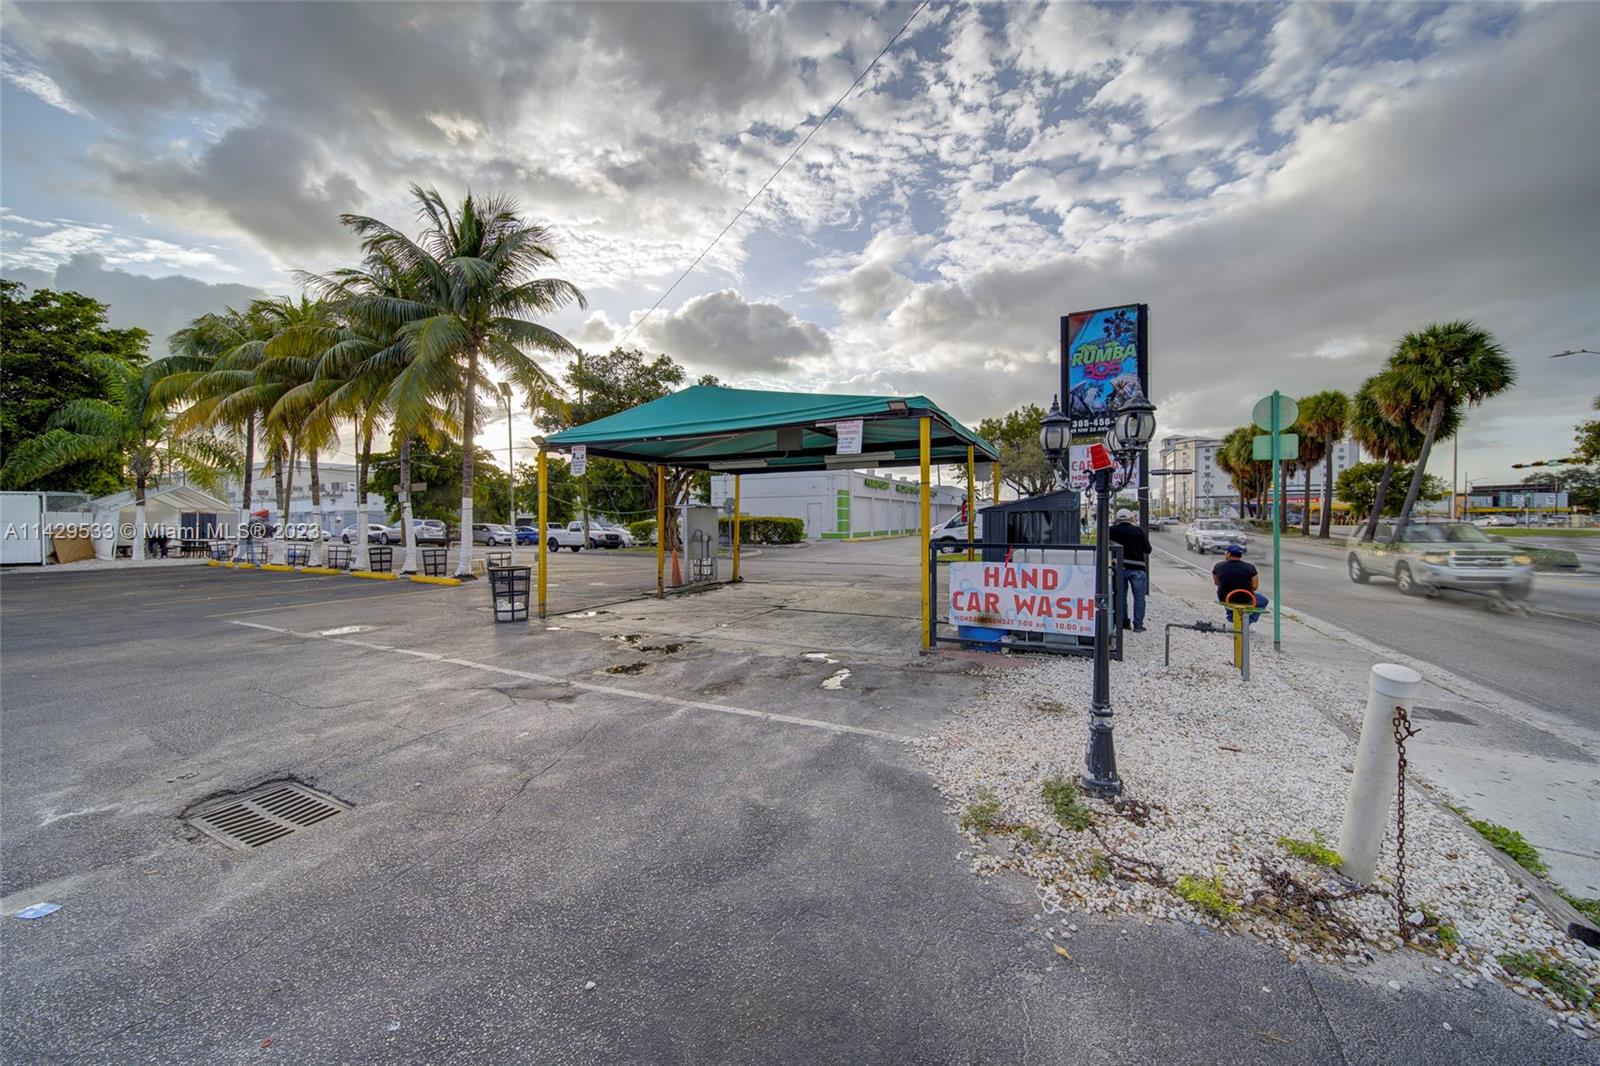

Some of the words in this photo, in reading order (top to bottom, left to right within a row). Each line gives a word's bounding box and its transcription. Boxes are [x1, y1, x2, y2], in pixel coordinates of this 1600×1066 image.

[1071, 343, 1137, 366] RUMBA
[1084, 360, 1121, 379] 305
[984, 566, 1059, 590] HAND
[952, 591, 1000, 614] CAR
[1013, 594, 1094, 621] WASH
